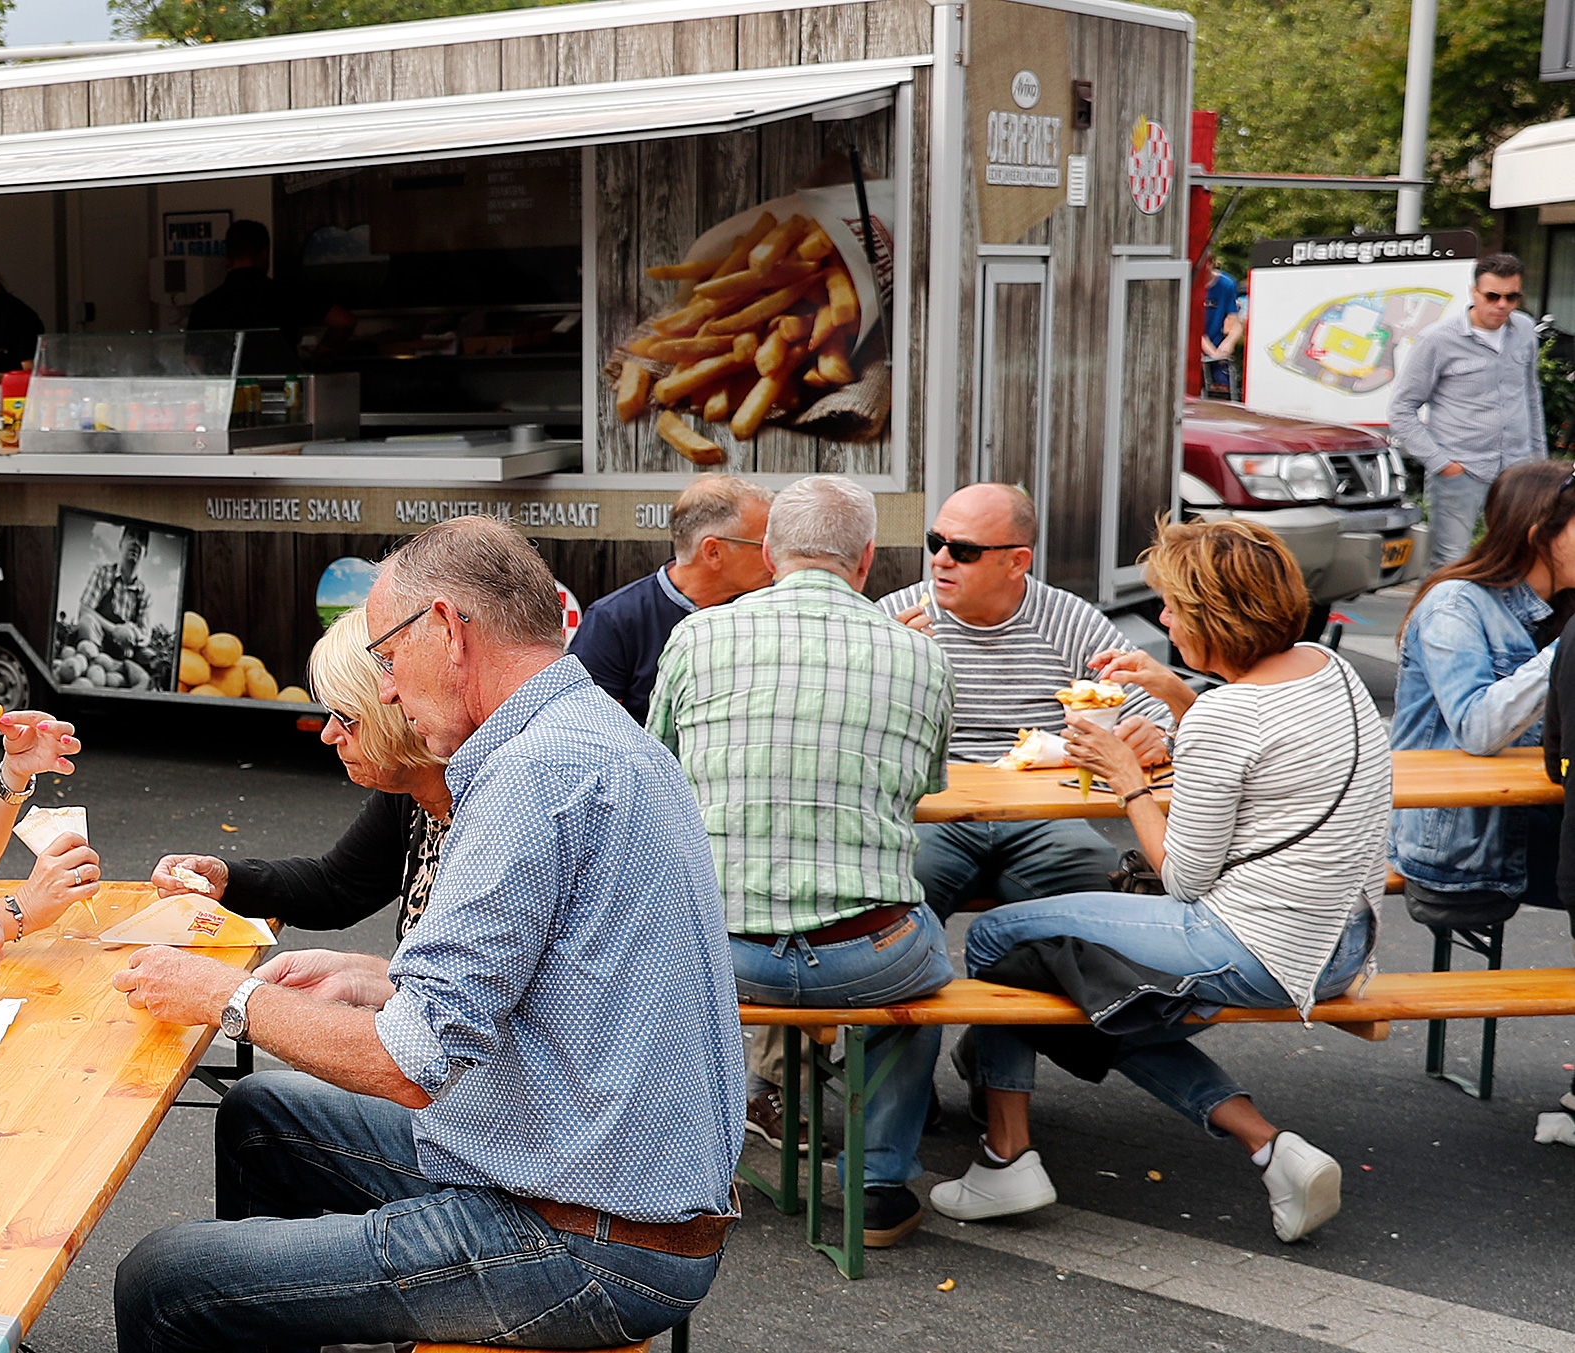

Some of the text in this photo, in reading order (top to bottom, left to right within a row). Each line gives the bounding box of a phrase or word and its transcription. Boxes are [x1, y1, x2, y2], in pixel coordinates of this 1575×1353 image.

[1292, 235, 1432, 265] plattegrond
[206, 498, 363, 522] AUTHENTIEKE SMAAK
[520, 502, 600, 527] GEMAAKT
[635, 503, 674, 529] GOU
